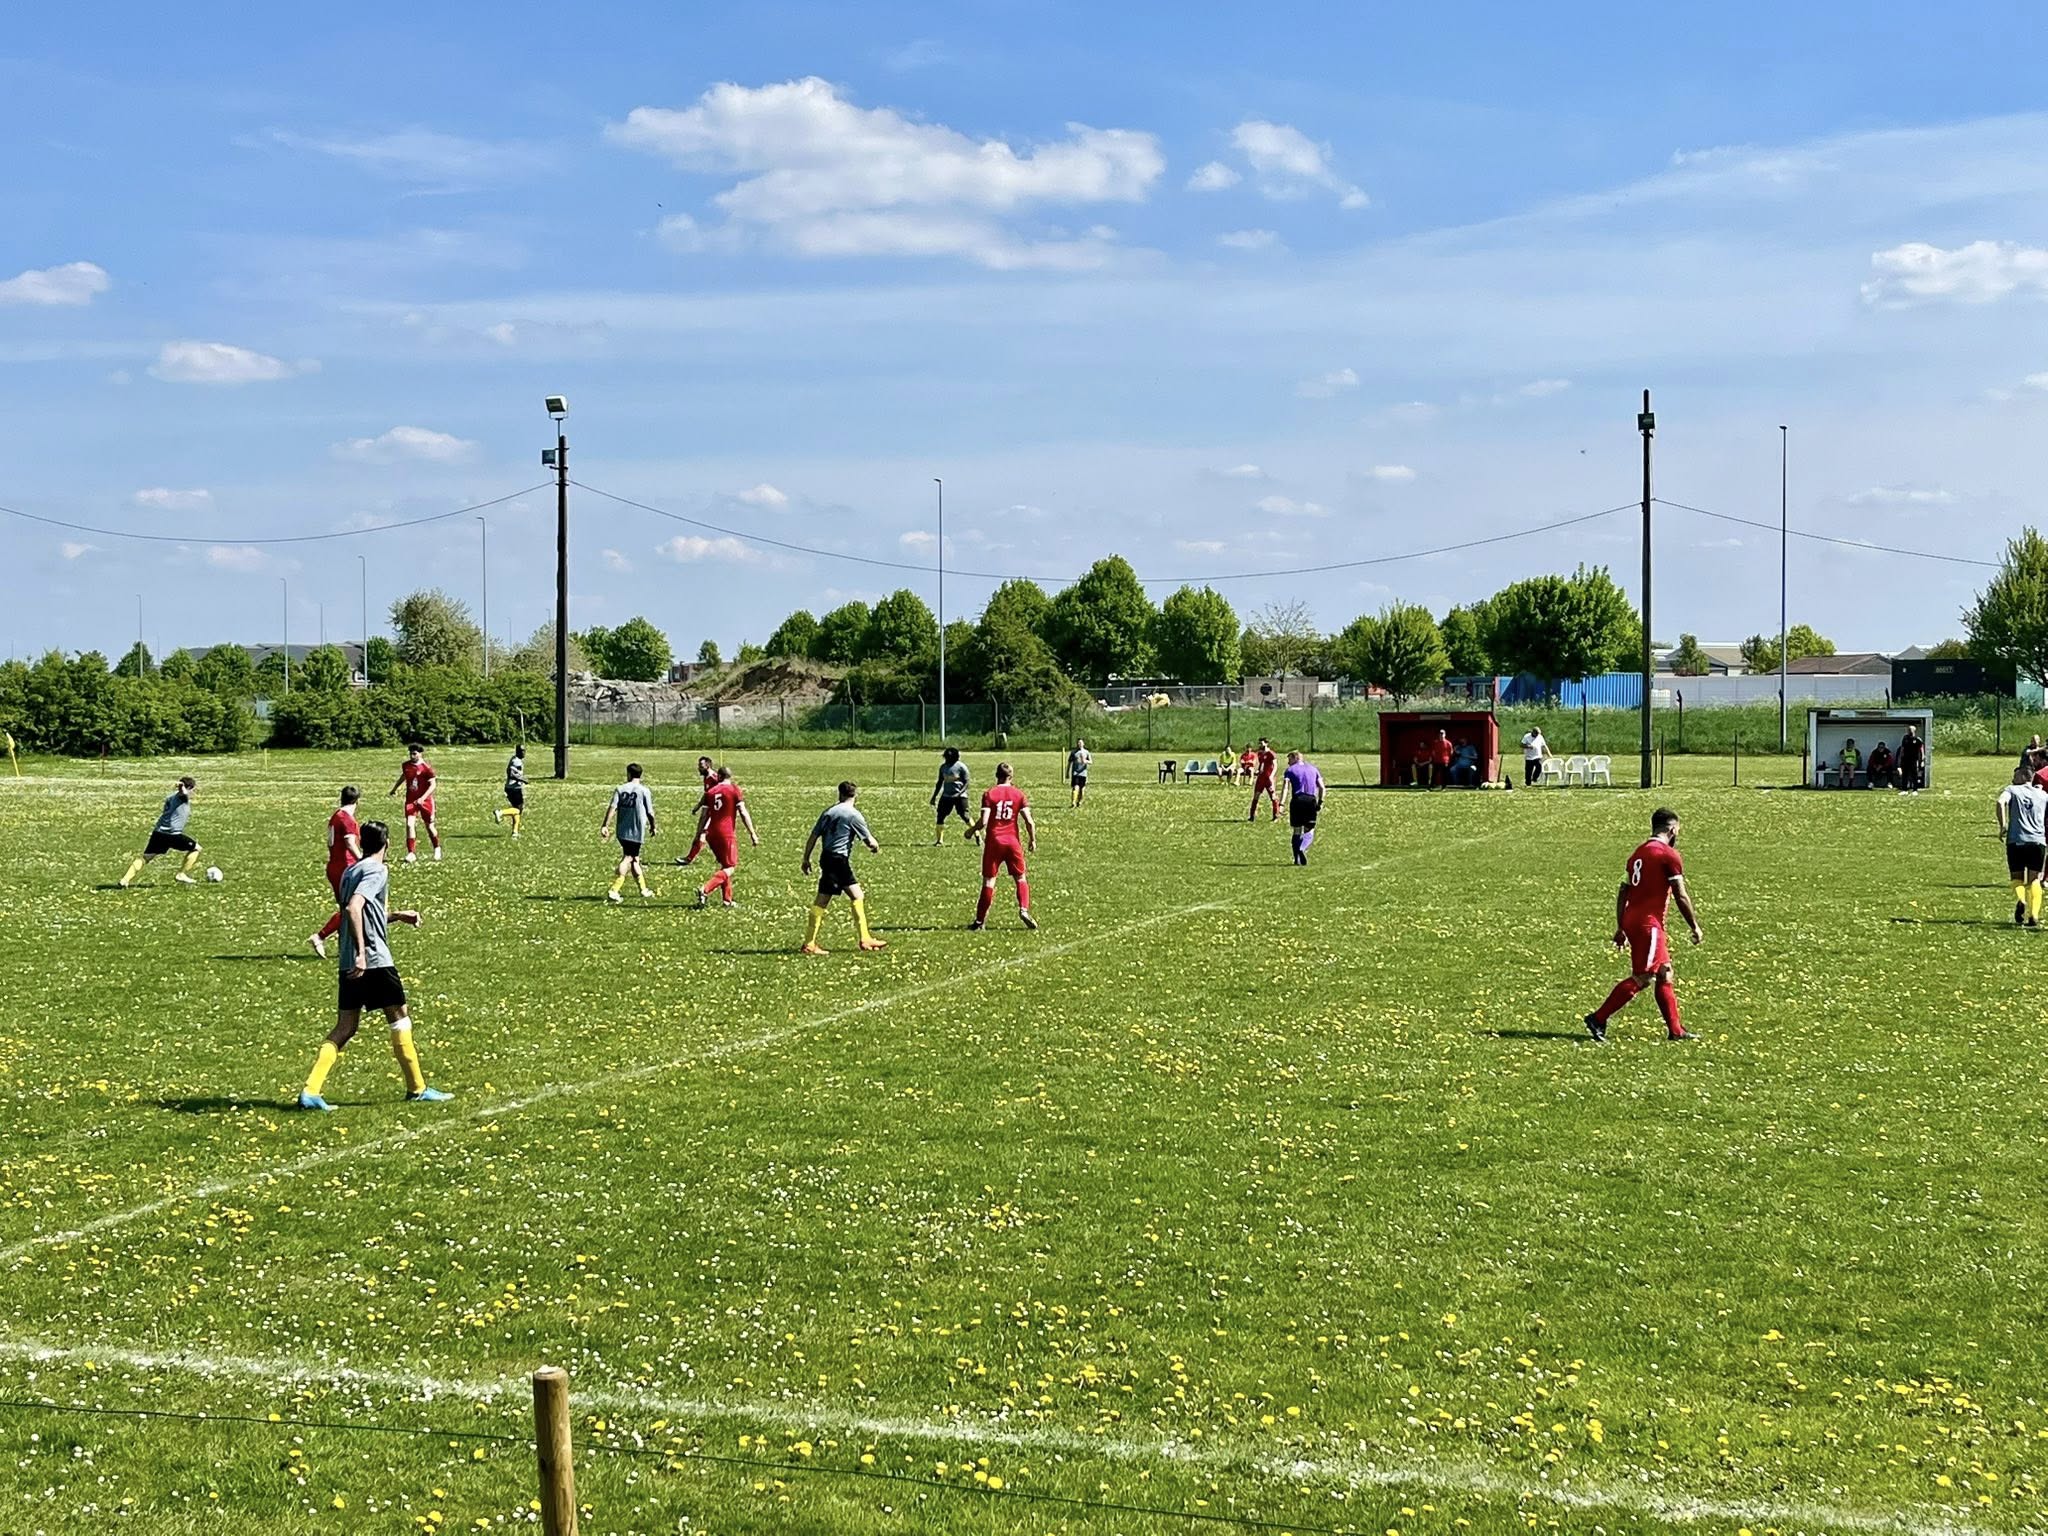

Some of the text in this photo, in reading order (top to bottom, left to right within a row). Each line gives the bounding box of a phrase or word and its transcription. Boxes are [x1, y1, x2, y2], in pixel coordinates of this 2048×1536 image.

[713, 793, 723, 811] 5
[995, 800, 1014, 820] 15
[1631, 858, 1643, 887] 8
